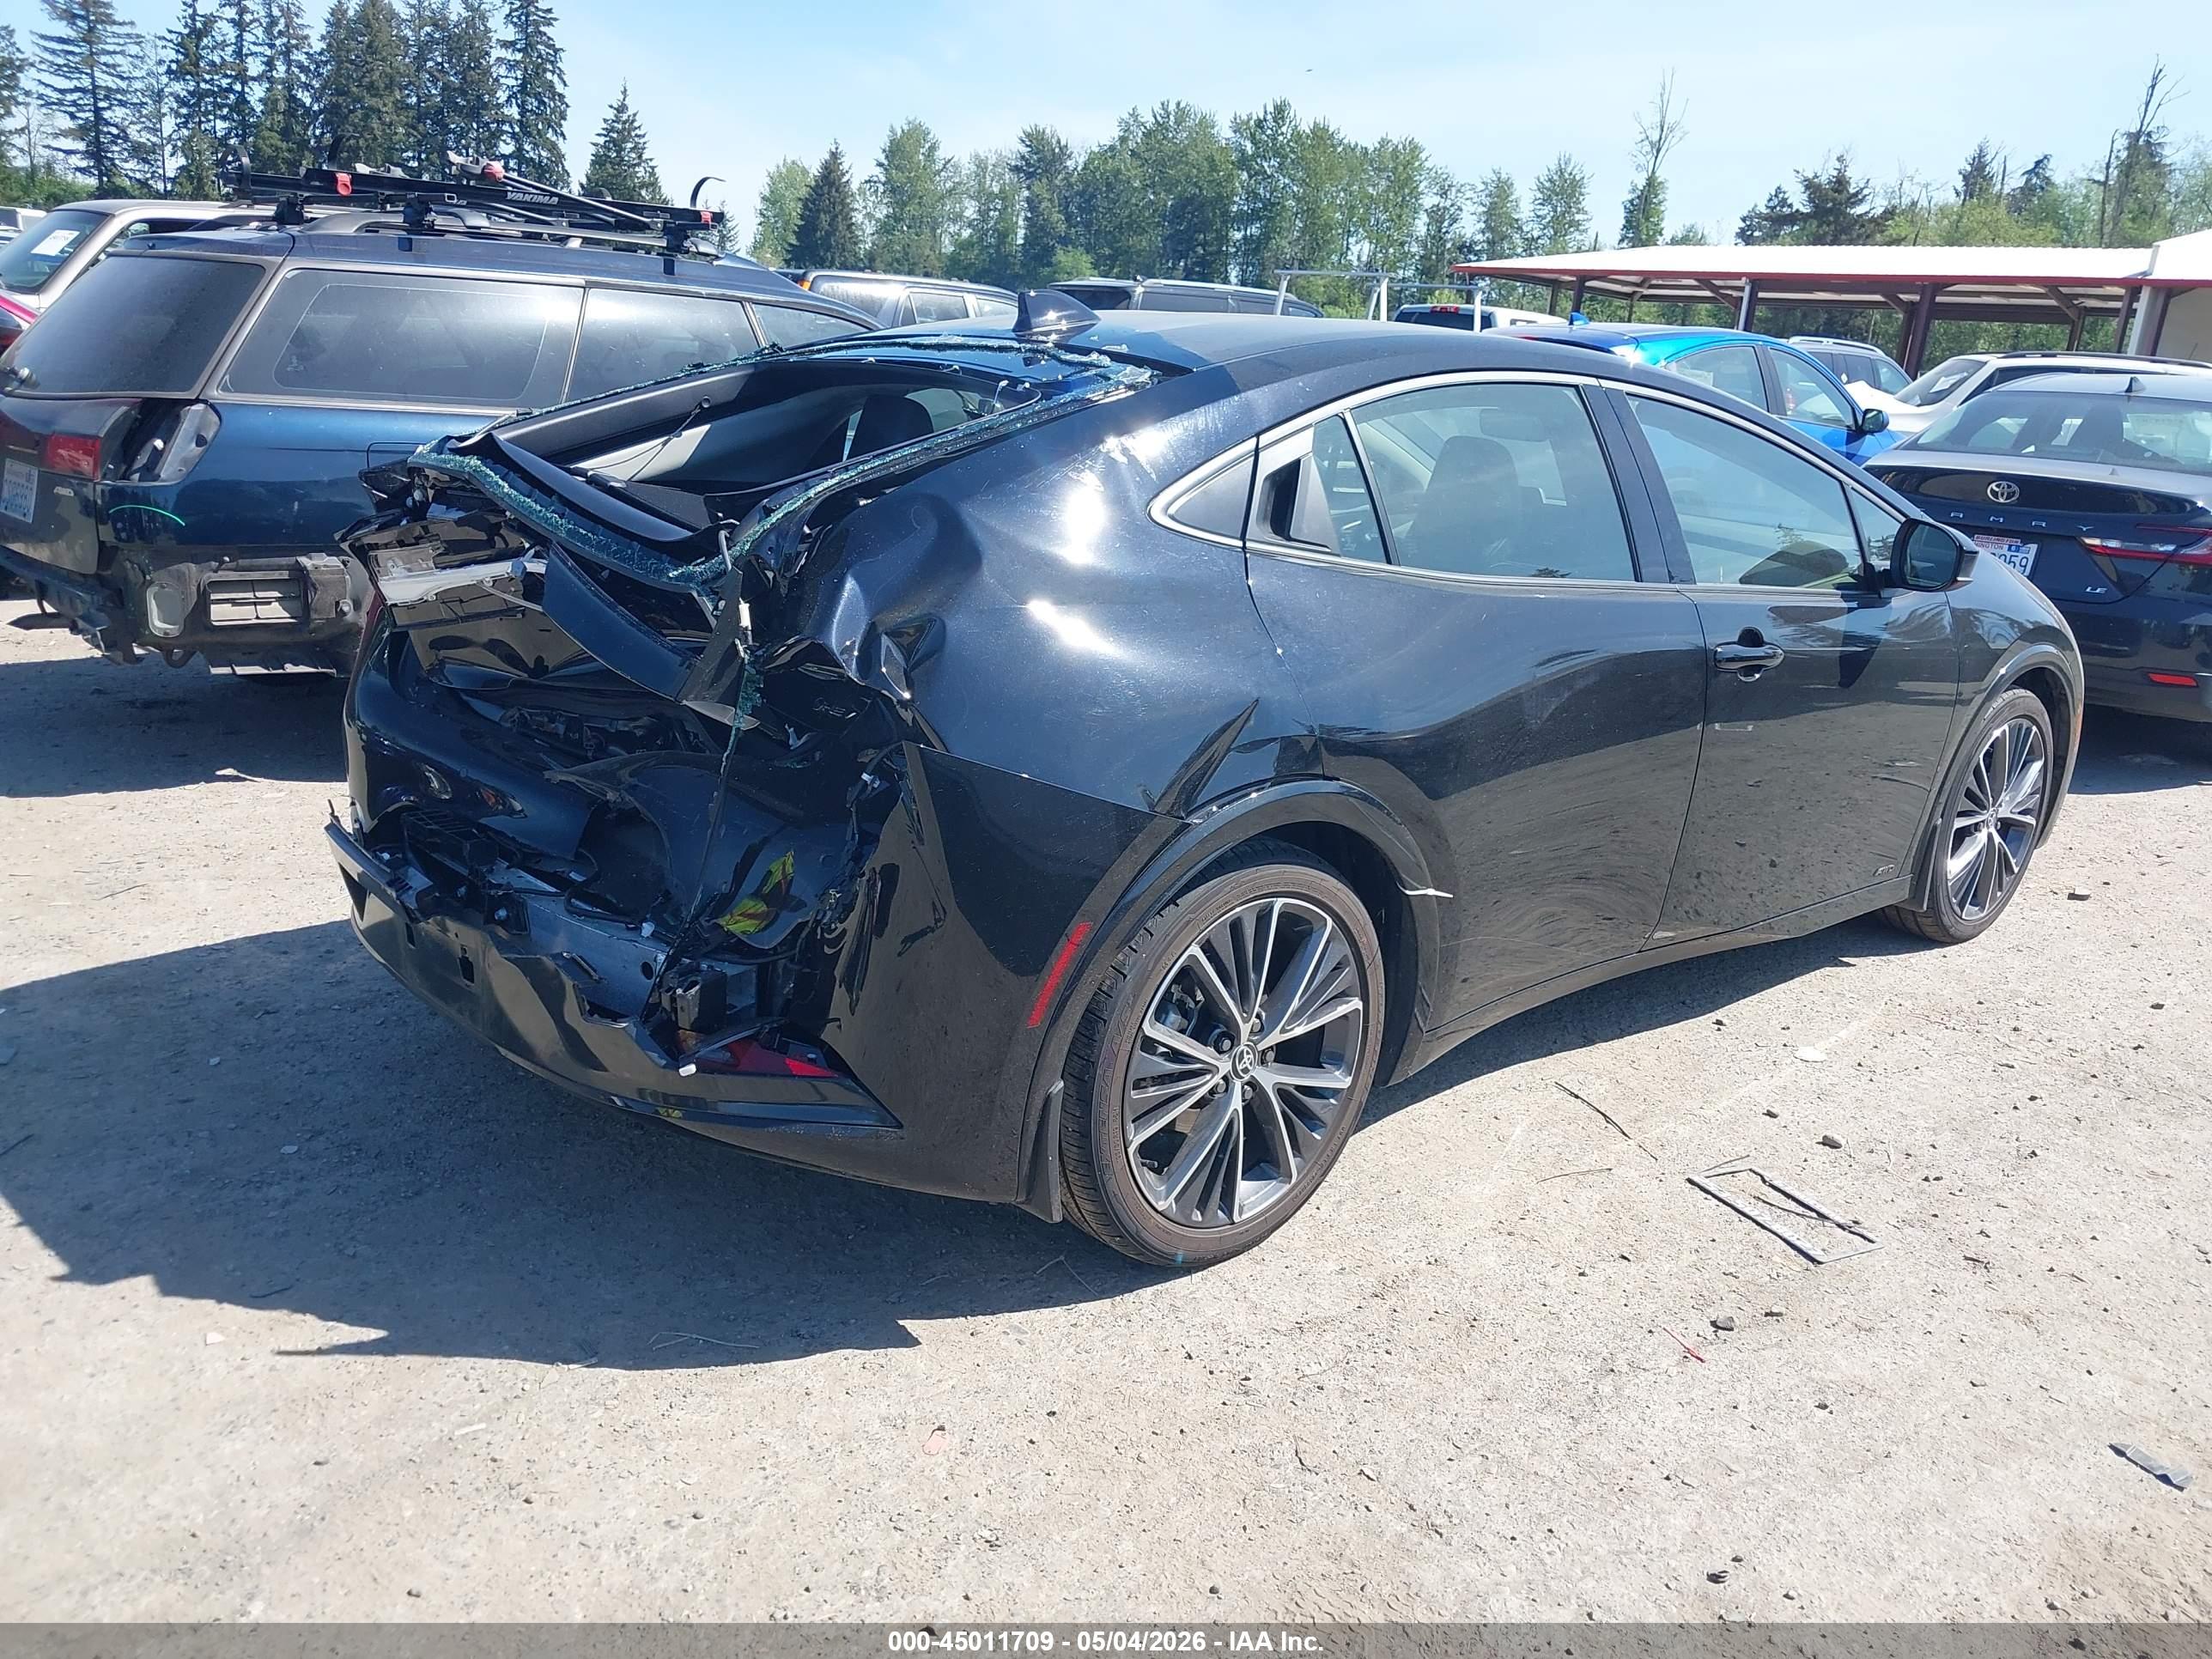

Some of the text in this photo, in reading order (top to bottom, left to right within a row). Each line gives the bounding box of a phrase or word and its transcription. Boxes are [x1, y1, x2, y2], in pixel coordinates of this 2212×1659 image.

[506, 191, 559, 205] YAKIMA
[1920, 508, 2094, 531] AMRY
[2085, 586, 2107, 594] LE
